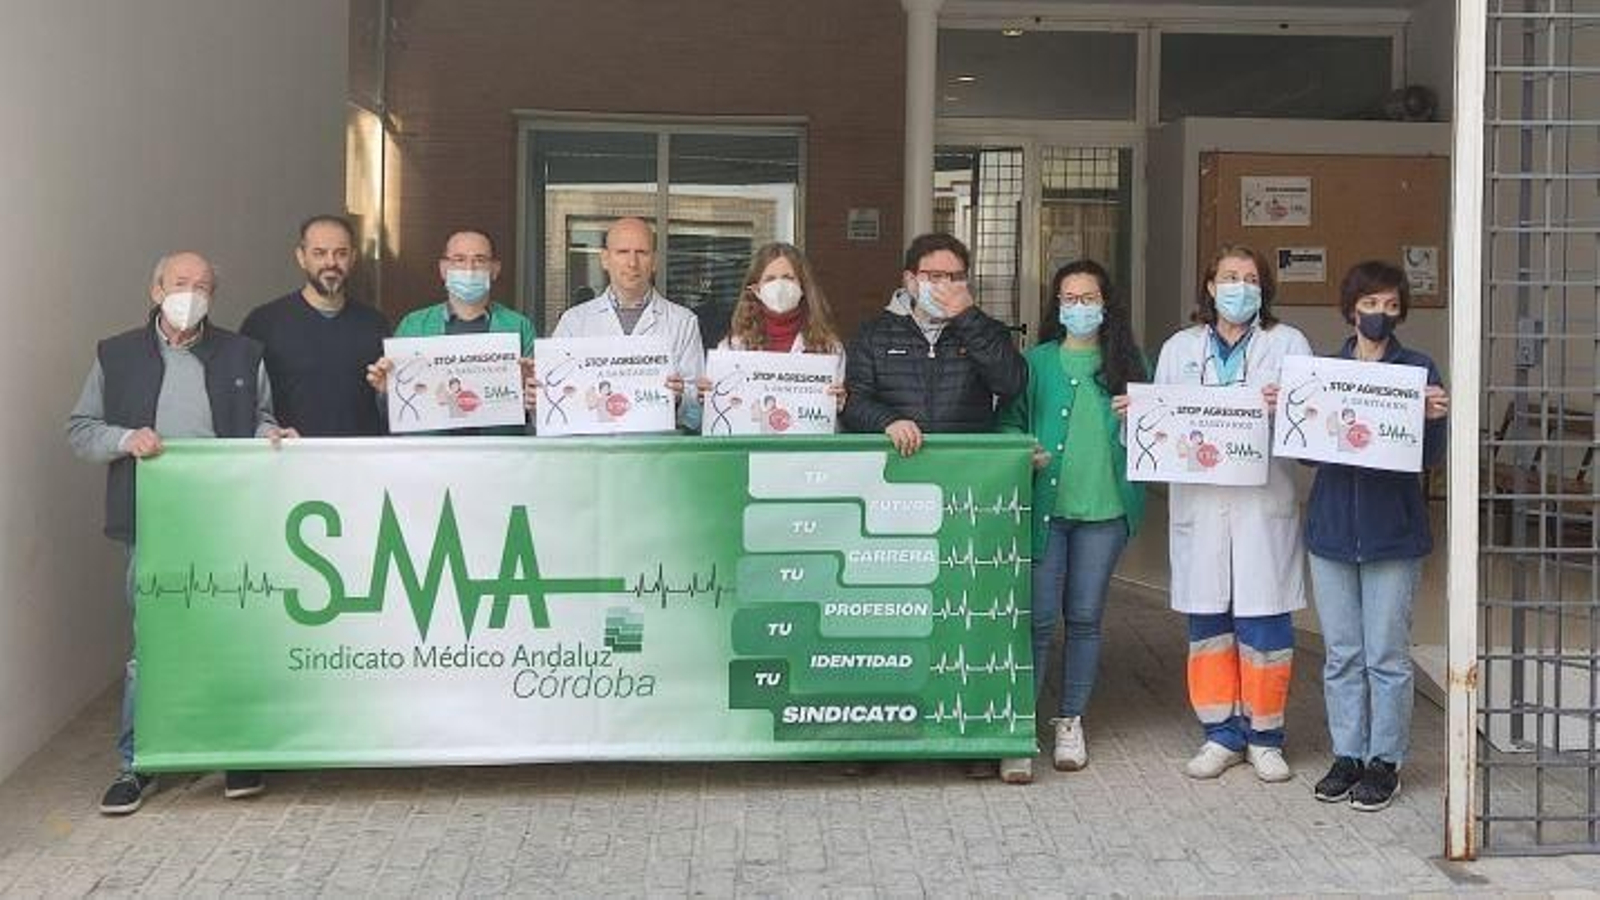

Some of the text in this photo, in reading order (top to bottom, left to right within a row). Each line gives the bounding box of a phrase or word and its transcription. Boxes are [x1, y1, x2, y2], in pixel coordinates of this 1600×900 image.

[434, 353, 516, 366] STOP AGRESIONES
[584, 355, 670, 367] STOP AGRESIONES
[752, 371, 834, 383] STOP AGRESIONES
[1328, 382, 1420, 399] STOP AGRESIONES
[1176, 406, 1264, 419] STOP AGRESIONES
[792, 522, 816, 533] TU
[848, 550, 935, 561] CARRERA
[285, 488, 552, 642] SMA
[780, 569, 803, 580] TU
[768, 624, 792, 635] TU
[288, 643, 612, 670] Sindicato Médico Andaluz
[811, 655, 912, 668] IDENTIDAD
[512, 667, 656, 698] Córdoba
[755, 673, 781, 685] TU
[782, 706, 918, 723] SINDICATO
